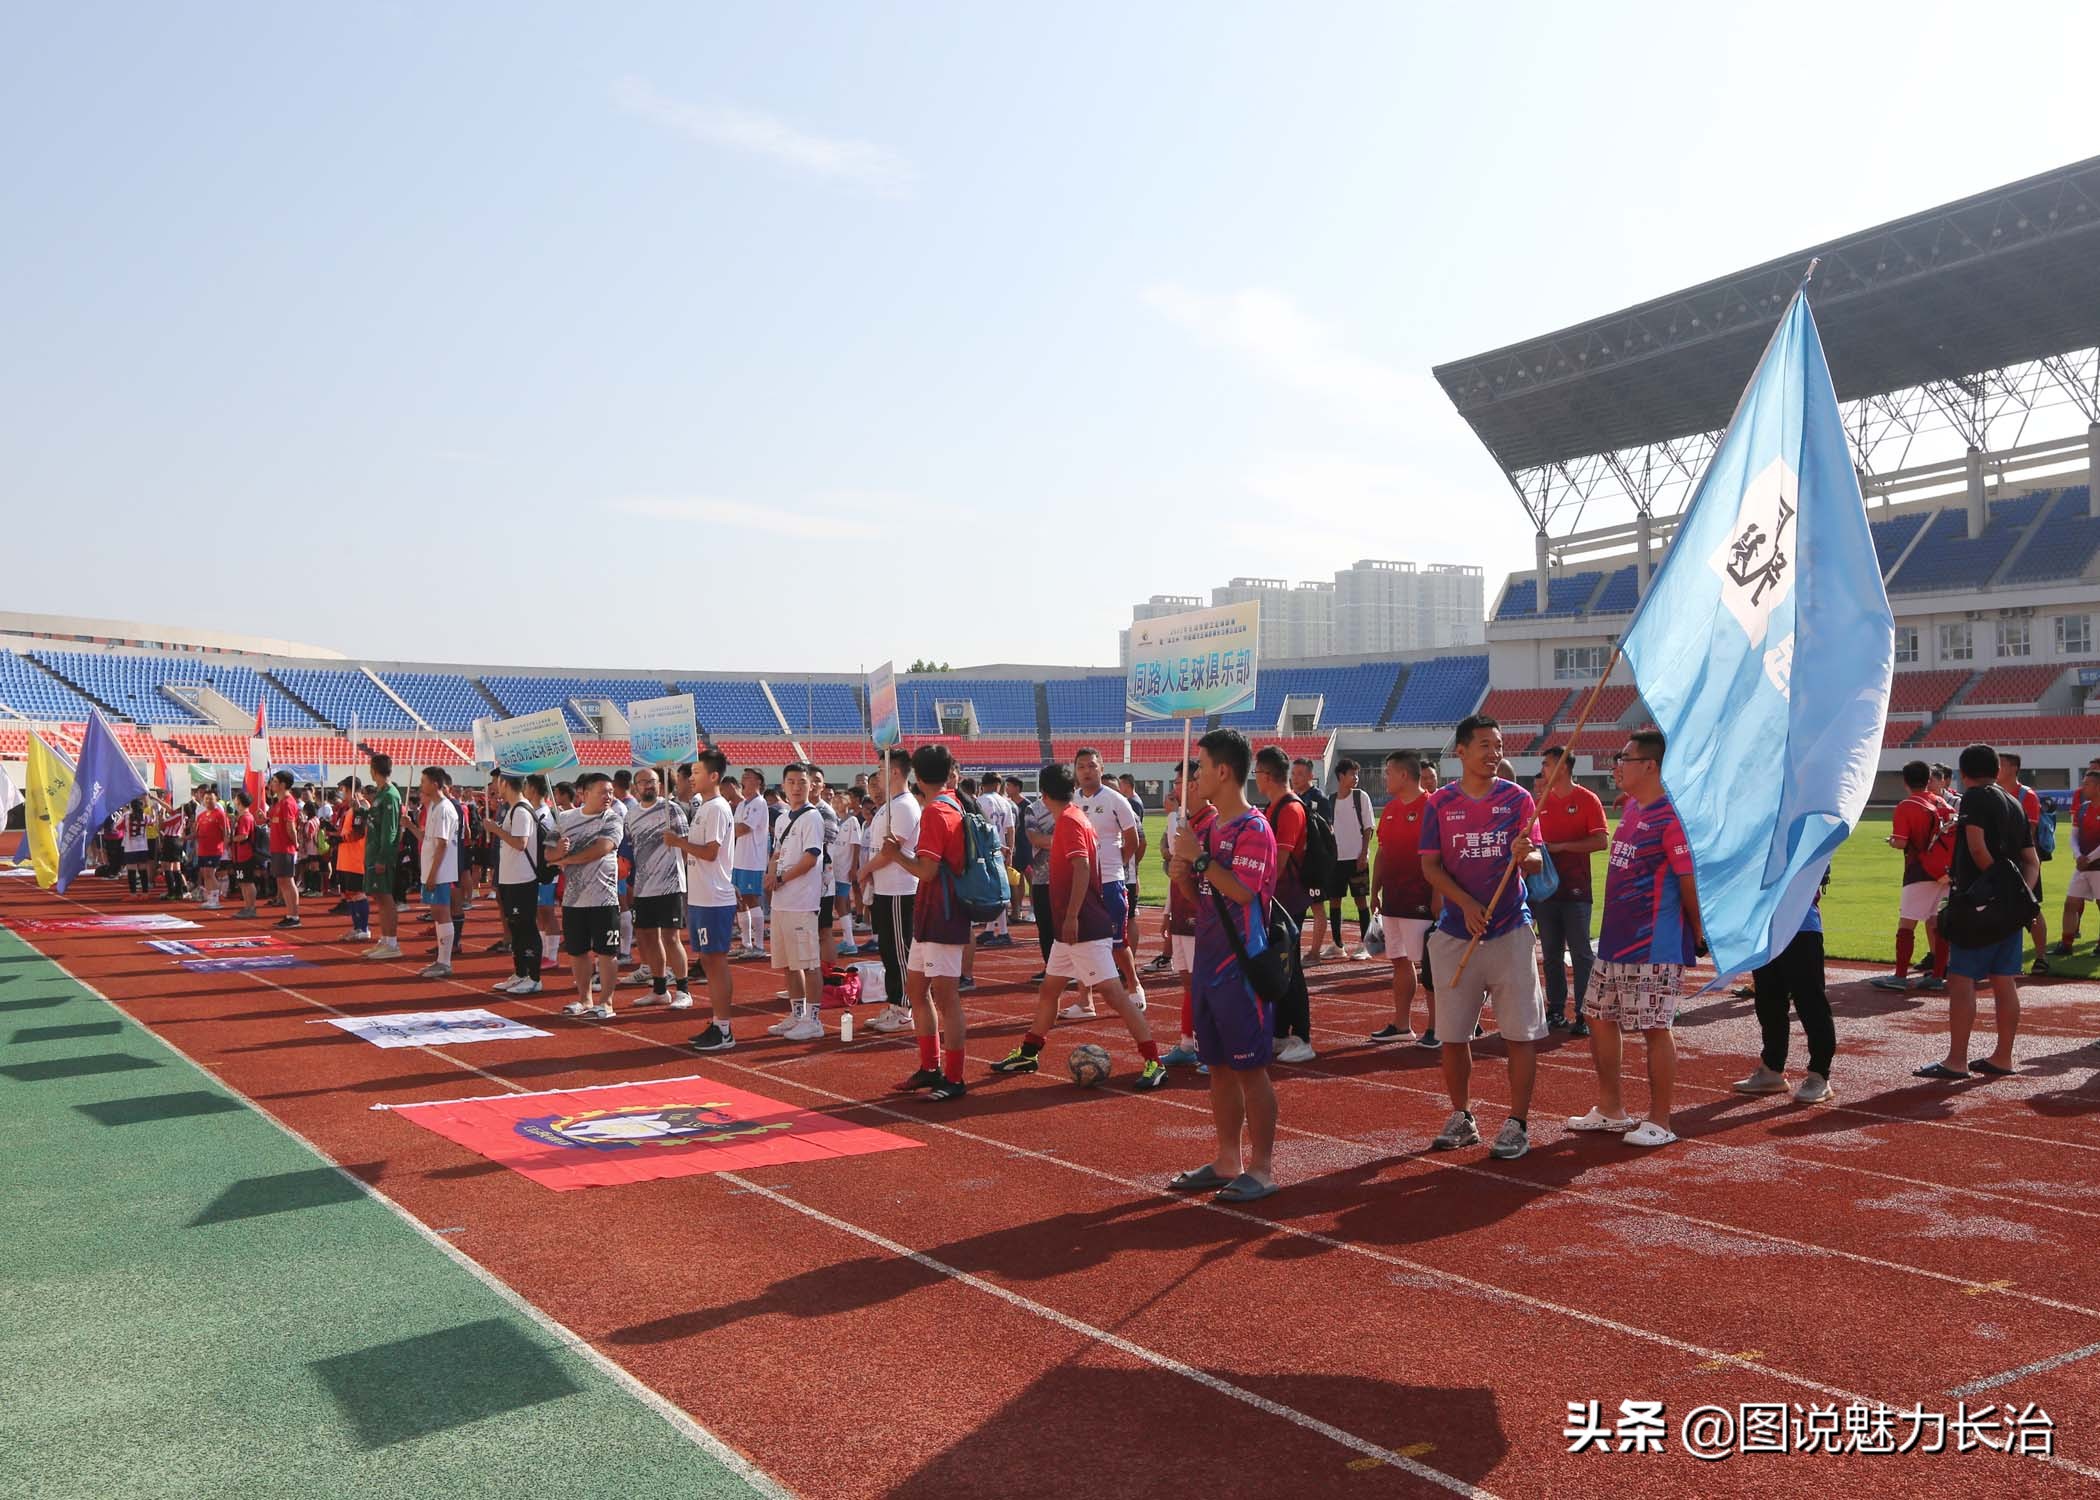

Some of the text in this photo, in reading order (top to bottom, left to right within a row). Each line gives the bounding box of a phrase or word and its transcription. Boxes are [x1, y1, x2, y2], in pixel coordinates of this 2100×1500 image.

[1134, 648, 1251, 697] 同路人足球俱乐部
[1452, 830, 1508, 848] 广晋车灯
[1459, 846, 1503, 859] 大王通讯
[606, 929, 620, 946] 22
